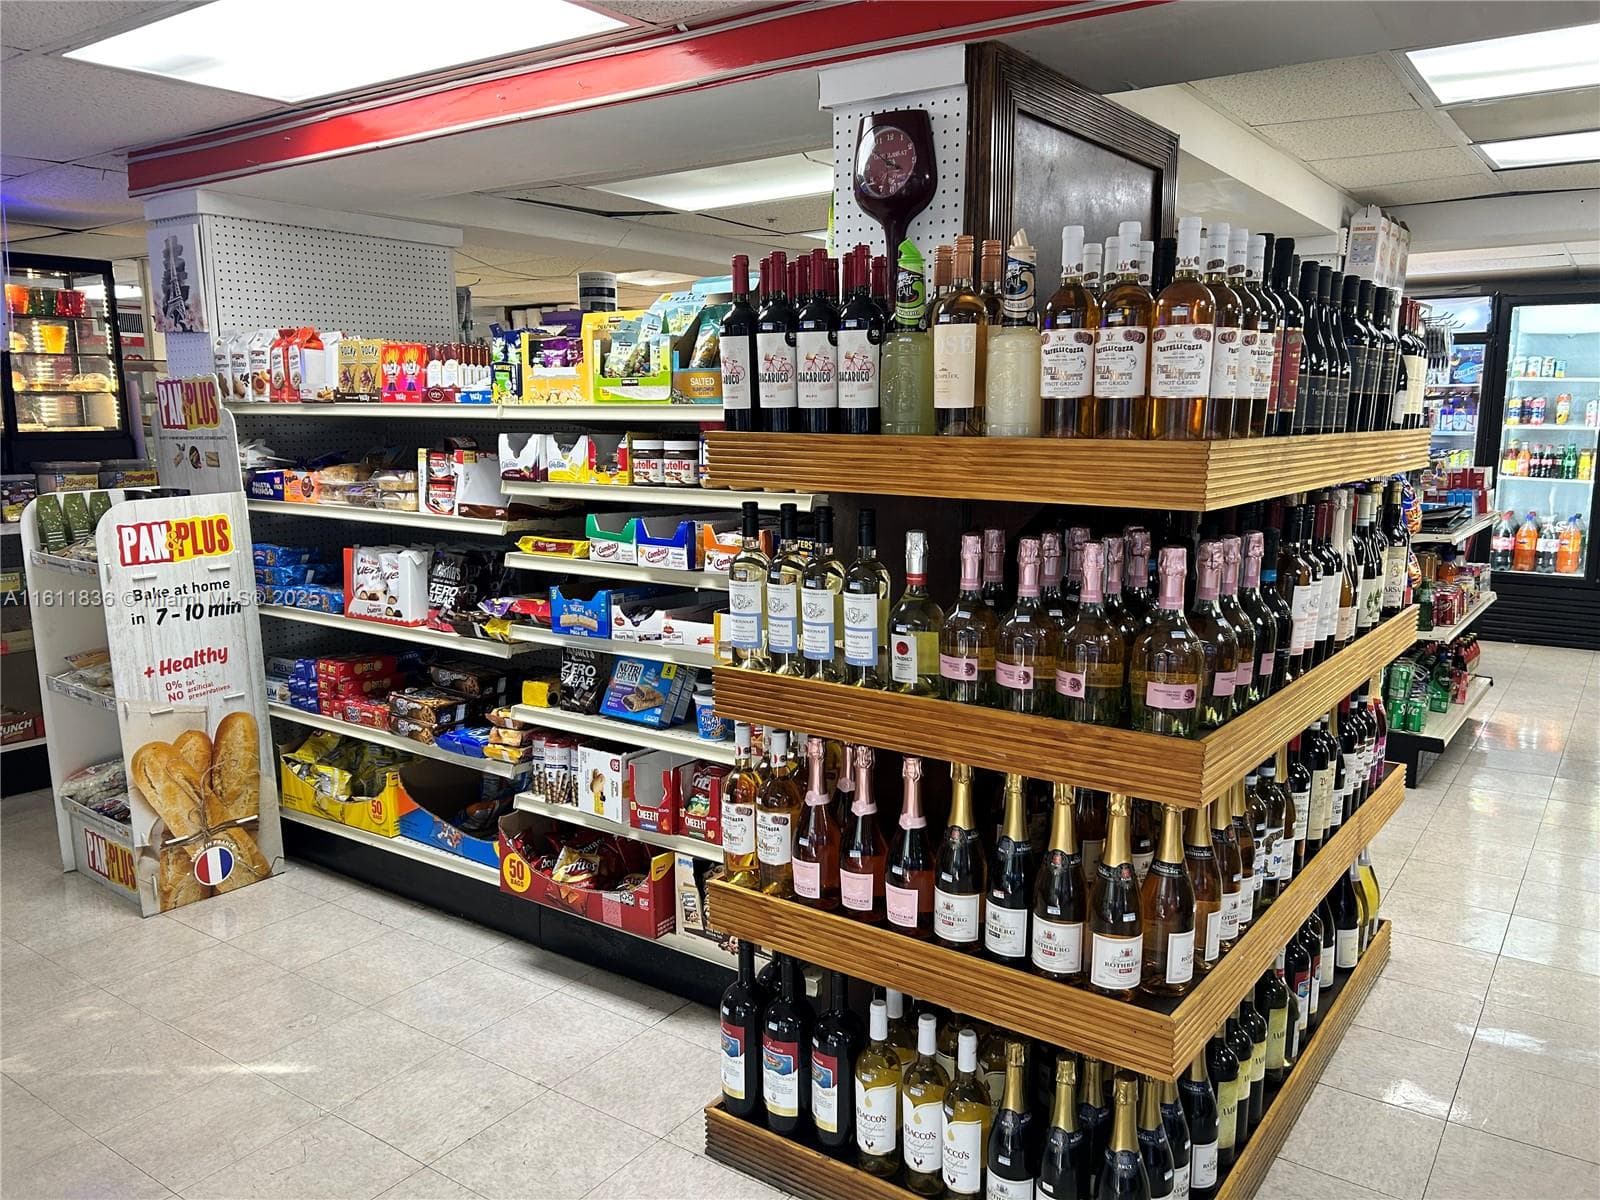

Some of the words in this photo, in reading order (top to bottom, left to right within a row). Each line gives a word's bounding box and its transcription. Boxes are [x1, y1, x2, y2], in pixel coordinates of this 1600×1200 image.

[689, 377, 715, 386] SALTED
[132, 587, 170, 602] Bake
[174, 583, 188, 596] at
[191, 580, 230, 594] home
[430, 582, 460, 596] ZERO
[131, 612, 146, 626] in
[156, 607, 168, 626] 7
[185, 602, 205, 622] 10
[207, 597, 242, 619] min
[159, 647, 228, 676] Healthy
[562, 661, 597, 677] ZERO
[619, 662, 643, 676] NUTRI
[560, 672, 595, 687] SUGAR
[616, 671, 641, 683] GRAIN
[165, 680, 183, 691] 0%
[168, 691, 185, 703] NO
[371, 799, 383, 816] 50
[509, 860, 525, 880] 50
[510, 878, 525, 888] BAGS
